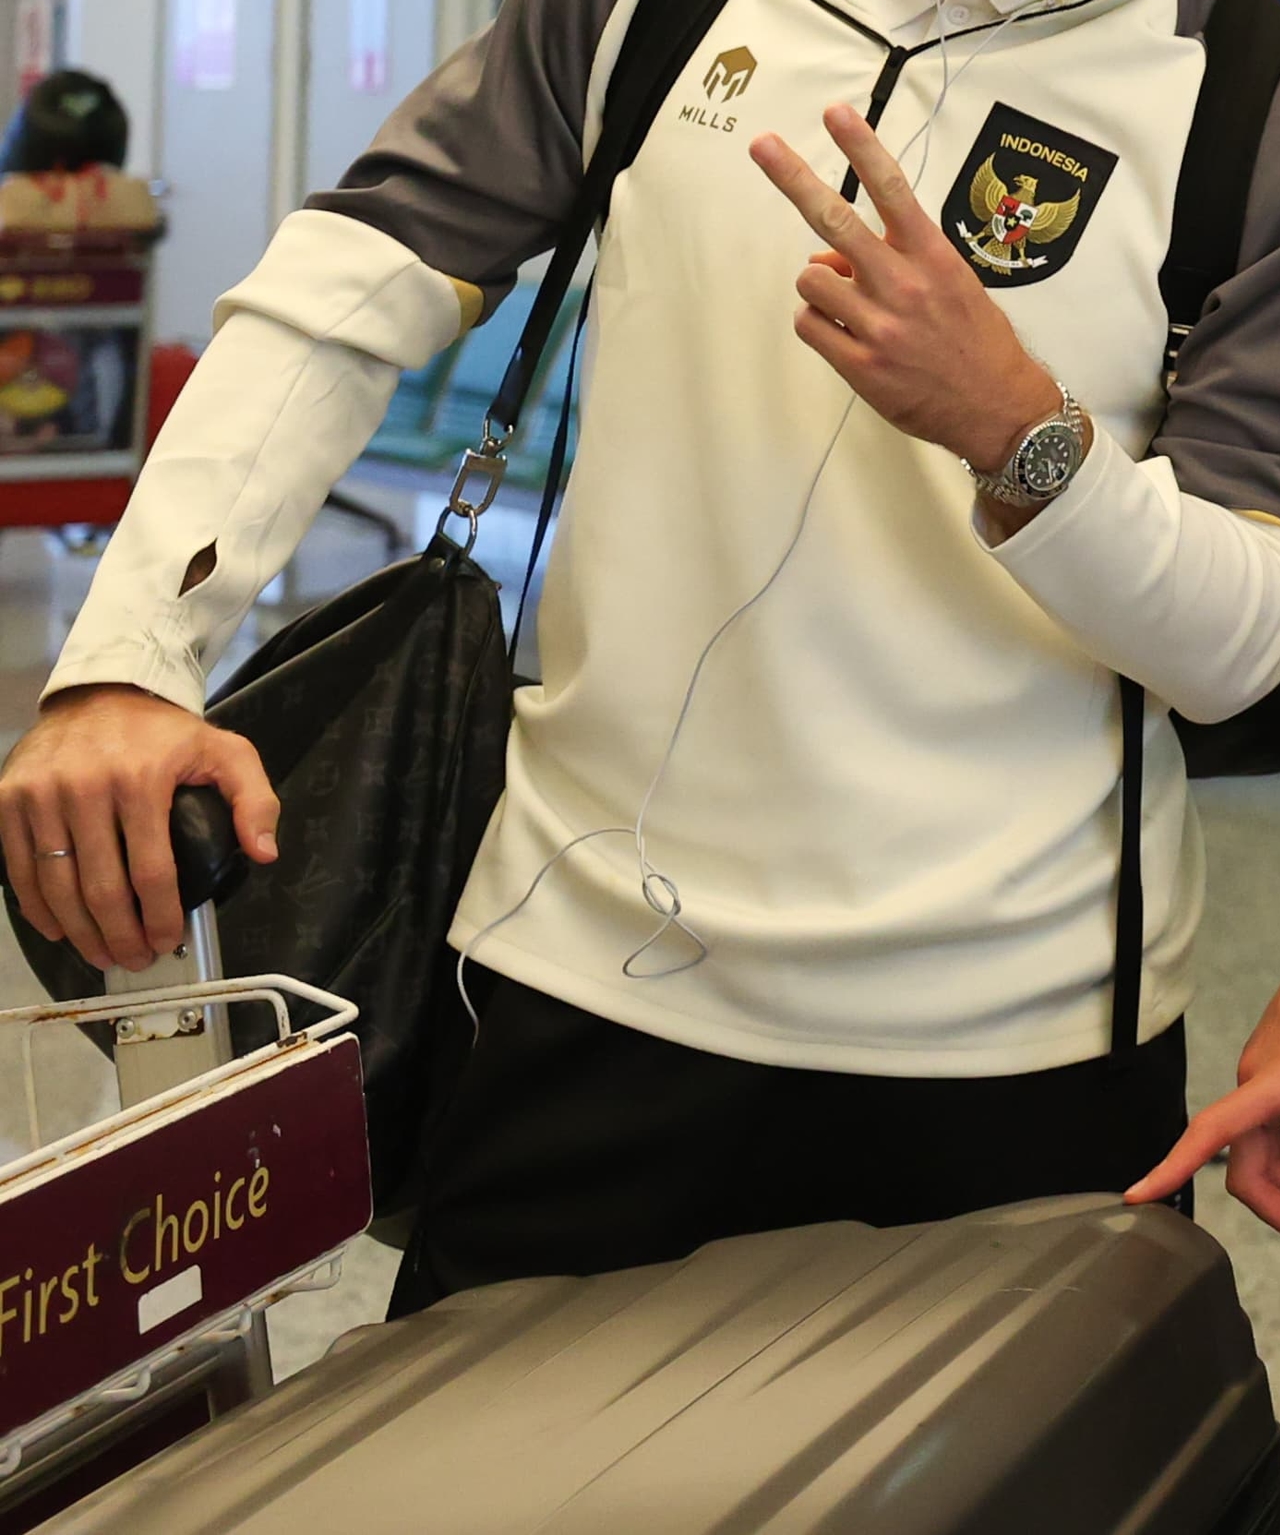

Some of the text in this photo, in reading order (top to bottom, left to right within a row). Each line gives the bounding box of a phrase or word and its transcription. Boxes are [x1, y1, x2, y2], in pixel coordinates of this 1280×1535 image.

[678, 104, 738, 134] MILLS
[999, 132, 1089, 183] INDONESIA
[0, 1166, 270, 1358] First Choice
